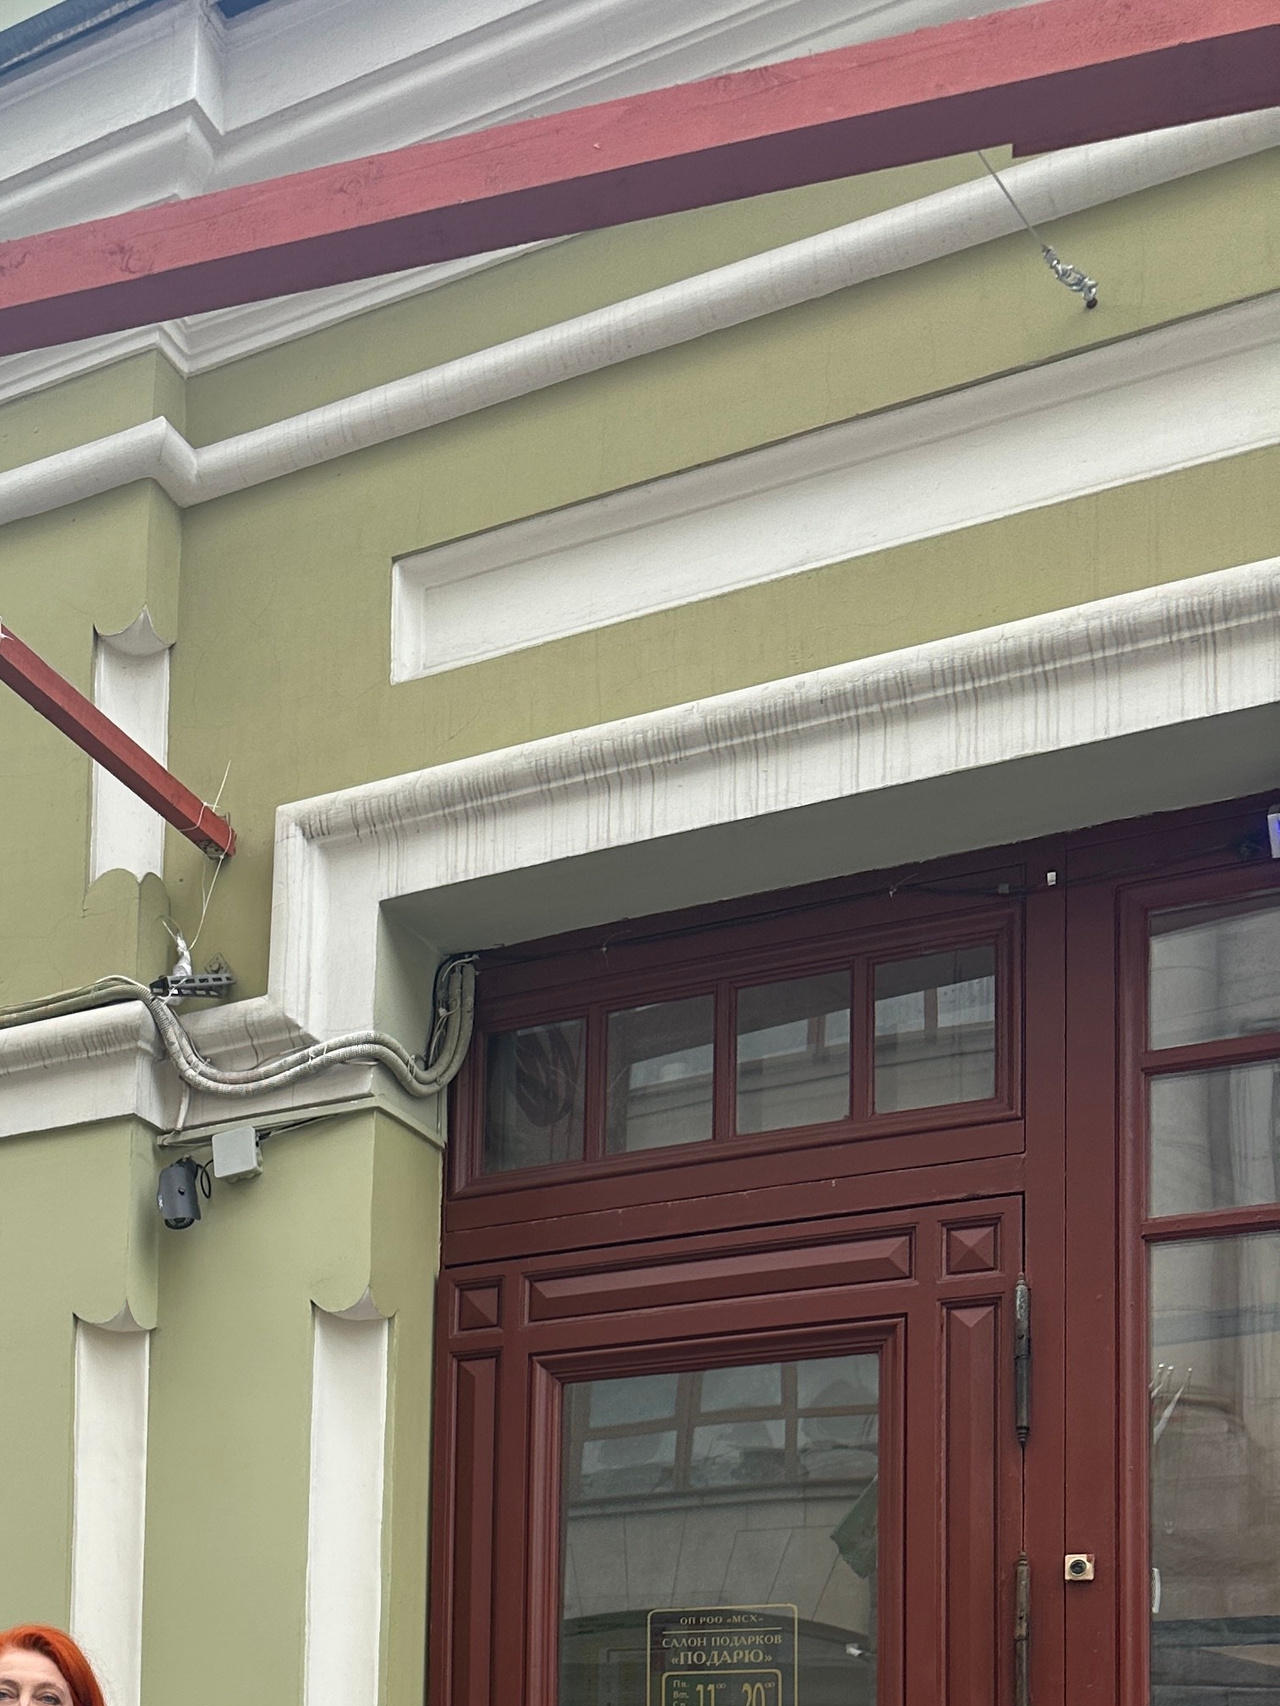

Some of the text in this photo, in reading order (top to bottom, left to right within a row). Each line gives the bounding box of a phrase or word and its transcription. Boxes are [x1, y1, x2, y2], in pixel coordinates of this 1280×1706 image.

[680, 1617, 695, 1625] ОП
[700, 1616, 722, 1624] РОО
[662, 1635, 782, 1647] САЛОН ПОДАРКОВ
[672, 1650, 772, 1666] «ПОДАРЮ»
